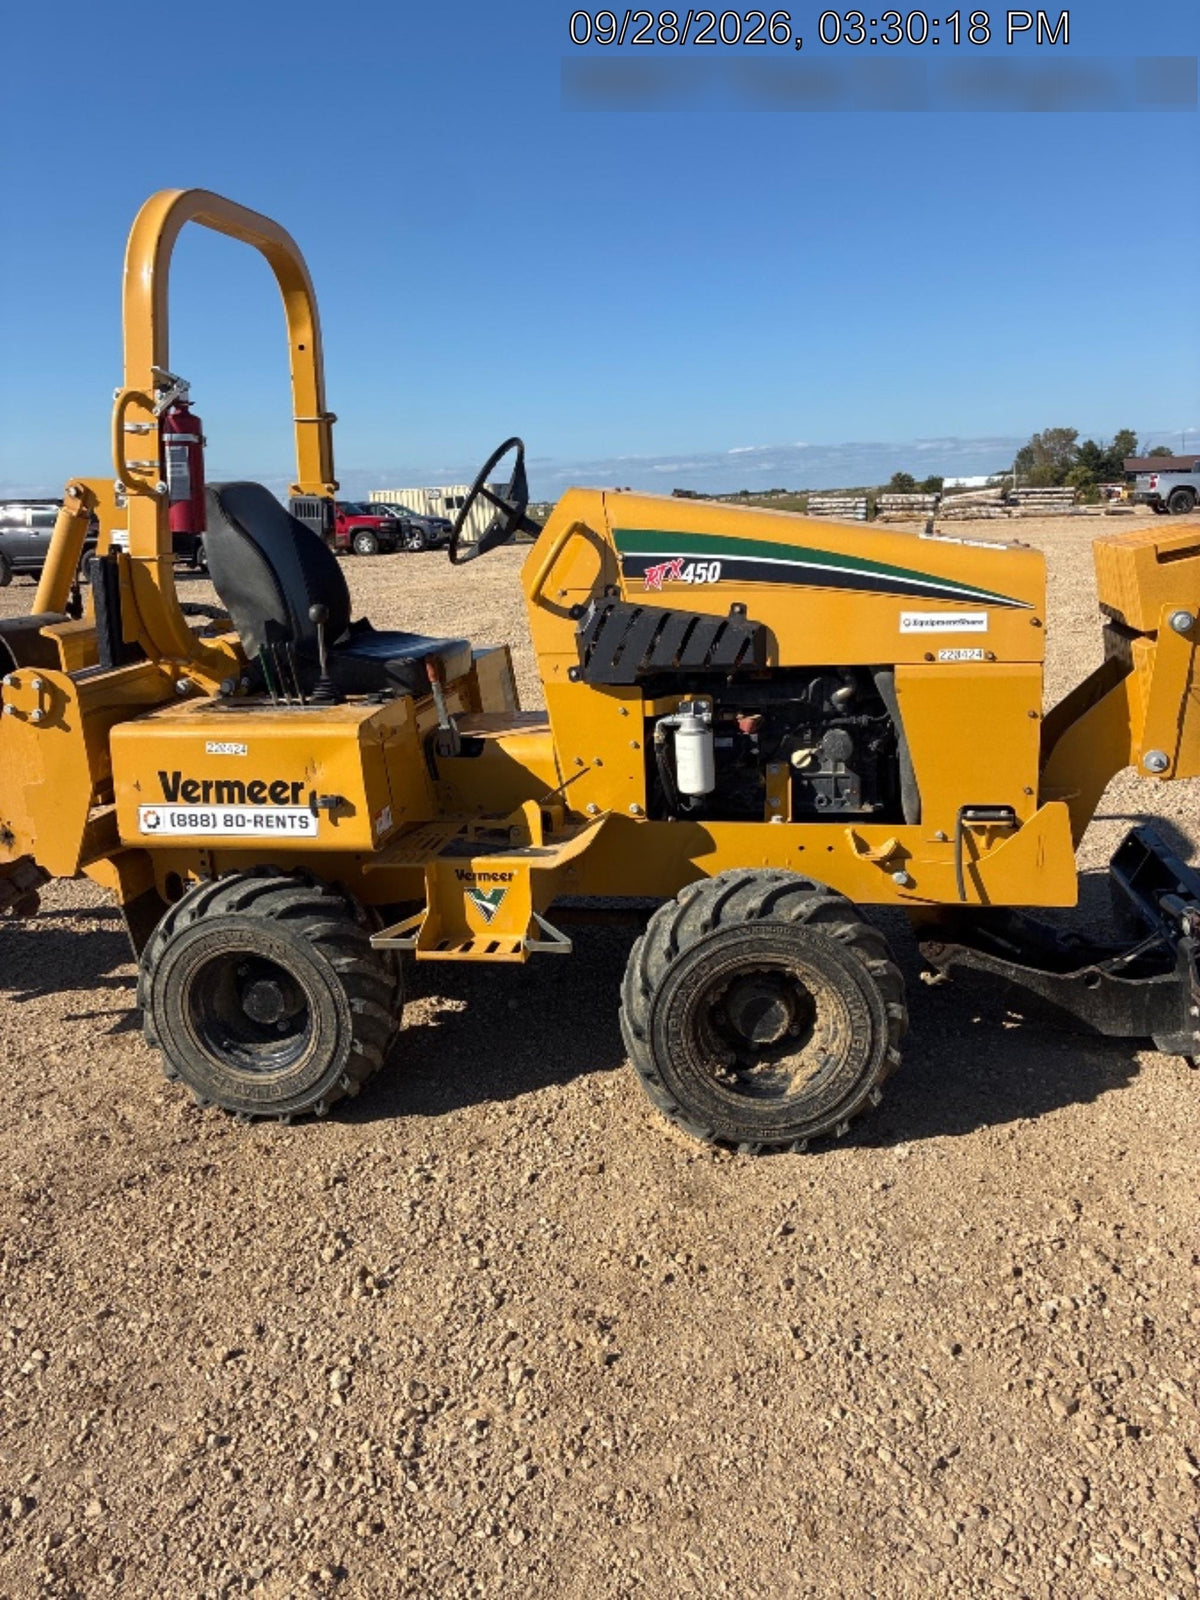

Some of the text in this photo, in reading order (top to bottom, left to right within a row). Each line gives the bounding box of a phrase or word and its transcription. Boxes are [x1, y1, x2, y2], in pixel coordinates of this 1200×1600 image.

[158, 770, 304, 804] Vermeer
[169, 811, 310, 830] (888) 80-RENTS
[455, 868, 513, 882] Vermeer
